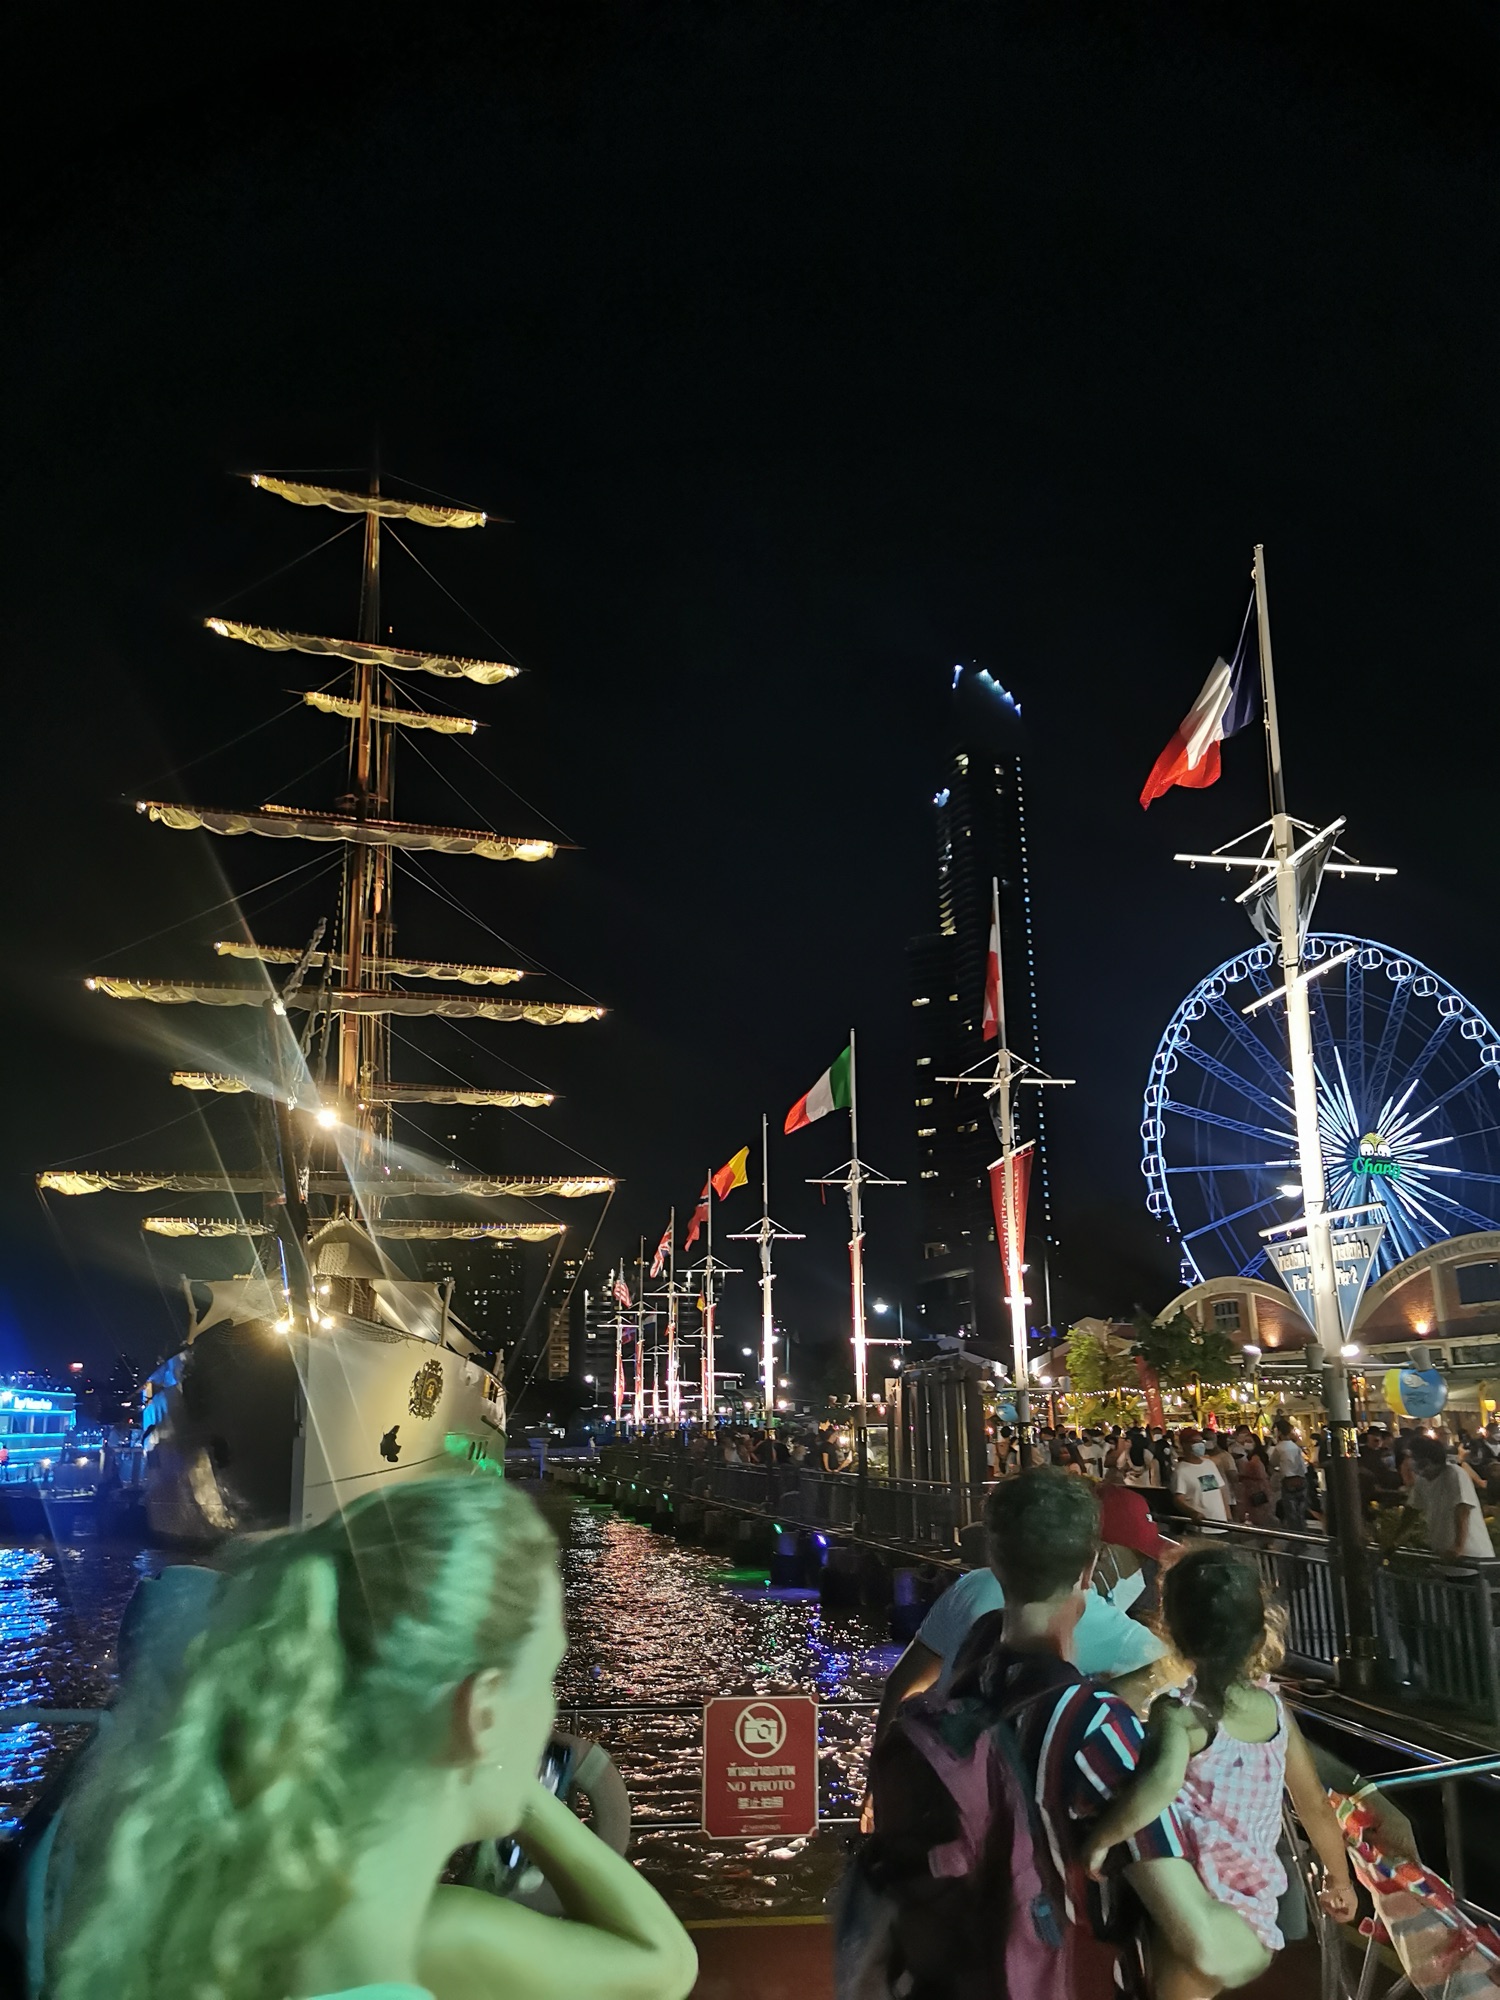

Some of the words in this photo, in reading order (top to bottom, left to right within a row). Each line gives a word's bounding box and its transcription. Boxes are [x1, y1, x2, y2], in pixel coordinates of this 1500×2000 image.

[1352, 1157, 1401, 1180] Chang
[1292, 1273, 1306, 1291] Pier
[726, 1781, 746, 1792] NO
[749, 1780, 796, 1792] PHOTO
